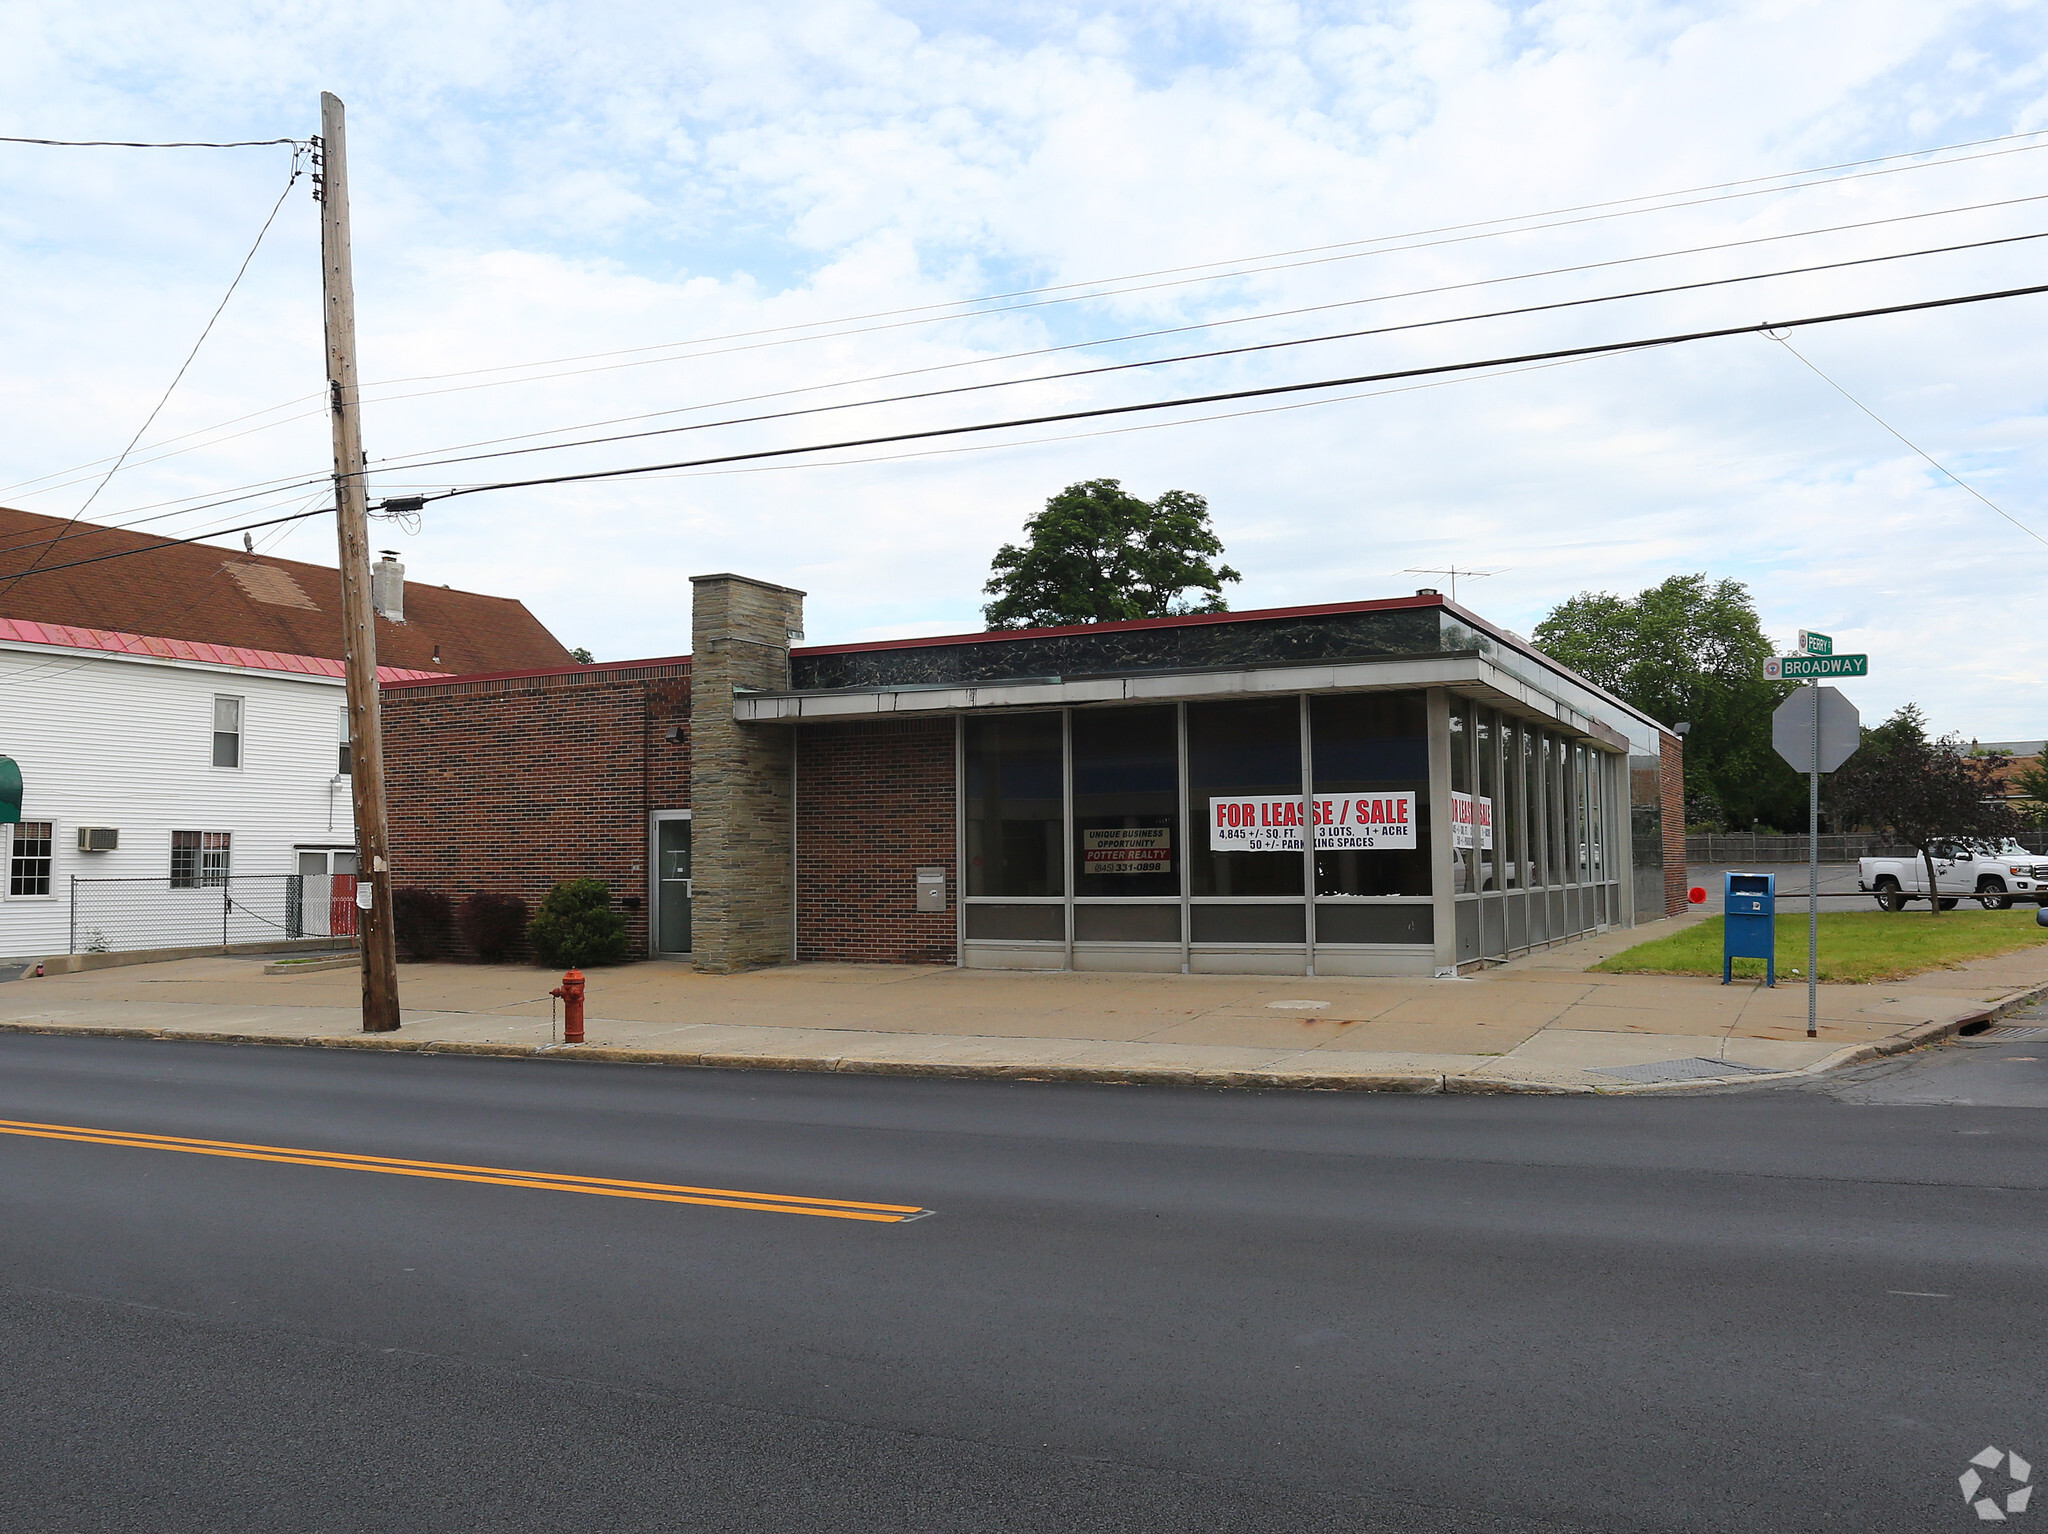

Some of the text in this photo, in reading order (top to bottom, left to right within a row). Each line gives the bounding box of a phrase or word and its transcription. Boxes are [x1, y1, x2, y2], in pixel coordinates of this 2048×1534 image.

[1808, 636, 1827, 652] PERRY
[1785, 659, 1863, 674] BROADWAY
[1217, 803, 1255, 827] FOR
[1262, 802, 1333, 826] LEASE
[1356, 799, 1408, 824] SALE
[1089, 829, 1163, 839] UNIQUE BUSINESS
[1219, 830, 1246, 839] 4,845
[1266, 829, 1281, 839] SQ.
[1284, 829, 1296, 838] FT.
[1320, 827, 1326, 837] 3
[1365, 826, 1370, 836] 1
[1382, 826, 1408, 836] ACRE
[1097, 840, 1156, 848] OPPORTUNITY
[1249, 840, 1262, 850] 50
[1337, 837, 1374, 847] SPACES
[1087, 850, 1167, 860] POTTER REALTY
[1094, 863, 1161, 873] (845) 331-0898
